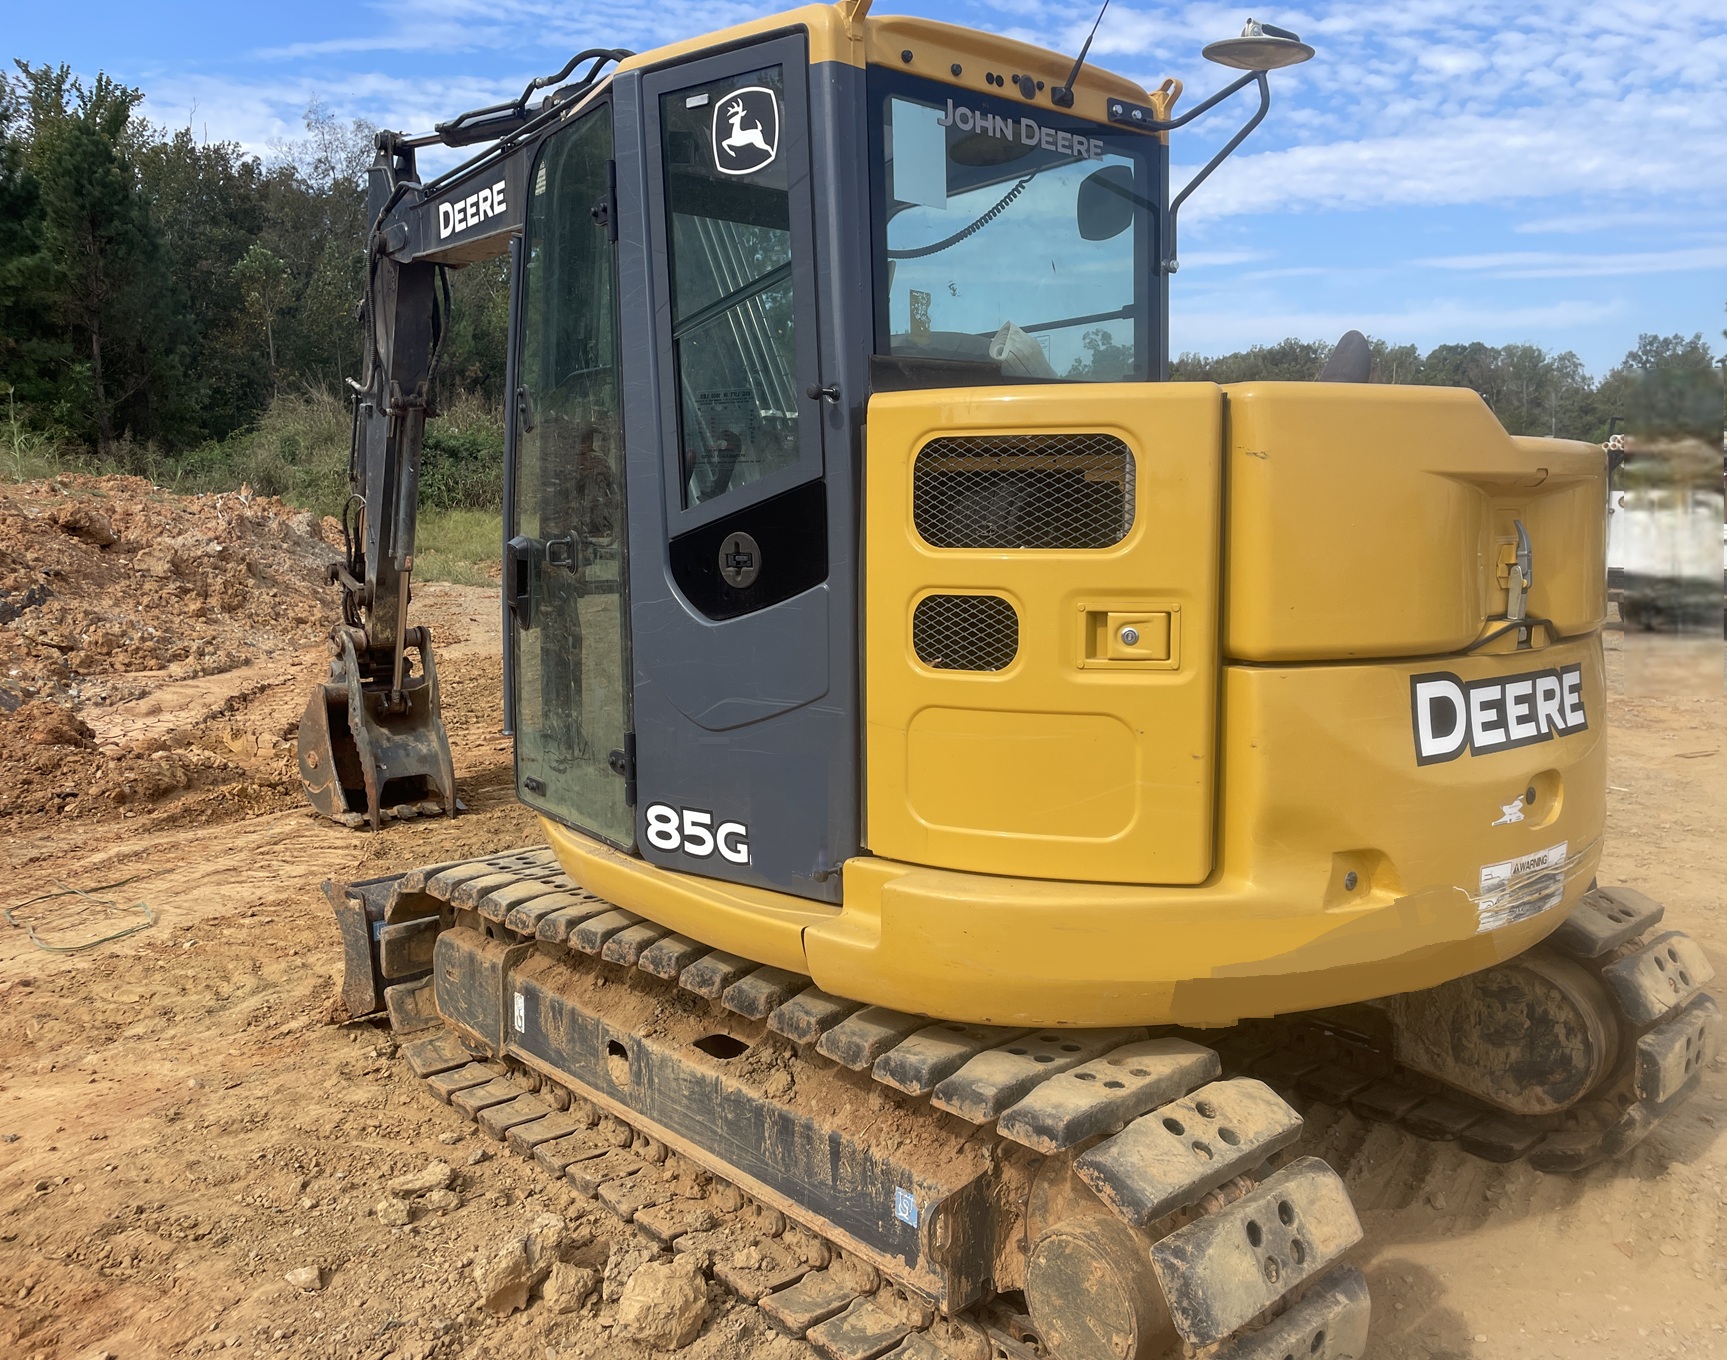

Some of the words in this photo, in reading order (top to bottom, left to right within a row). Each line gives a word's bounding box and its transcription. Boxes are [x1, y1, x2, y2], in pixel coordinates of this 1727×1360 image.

[937, 98, 1013, 141] JOHN
[1020, 117, 1103, 162] DEERE
[438, 180, 507, 240] DEERE
[1415, 669, 1586, 758] DEERE
[645, 803, 750, 864] 85G
[1519, 854, 1548, 873] WARNING
